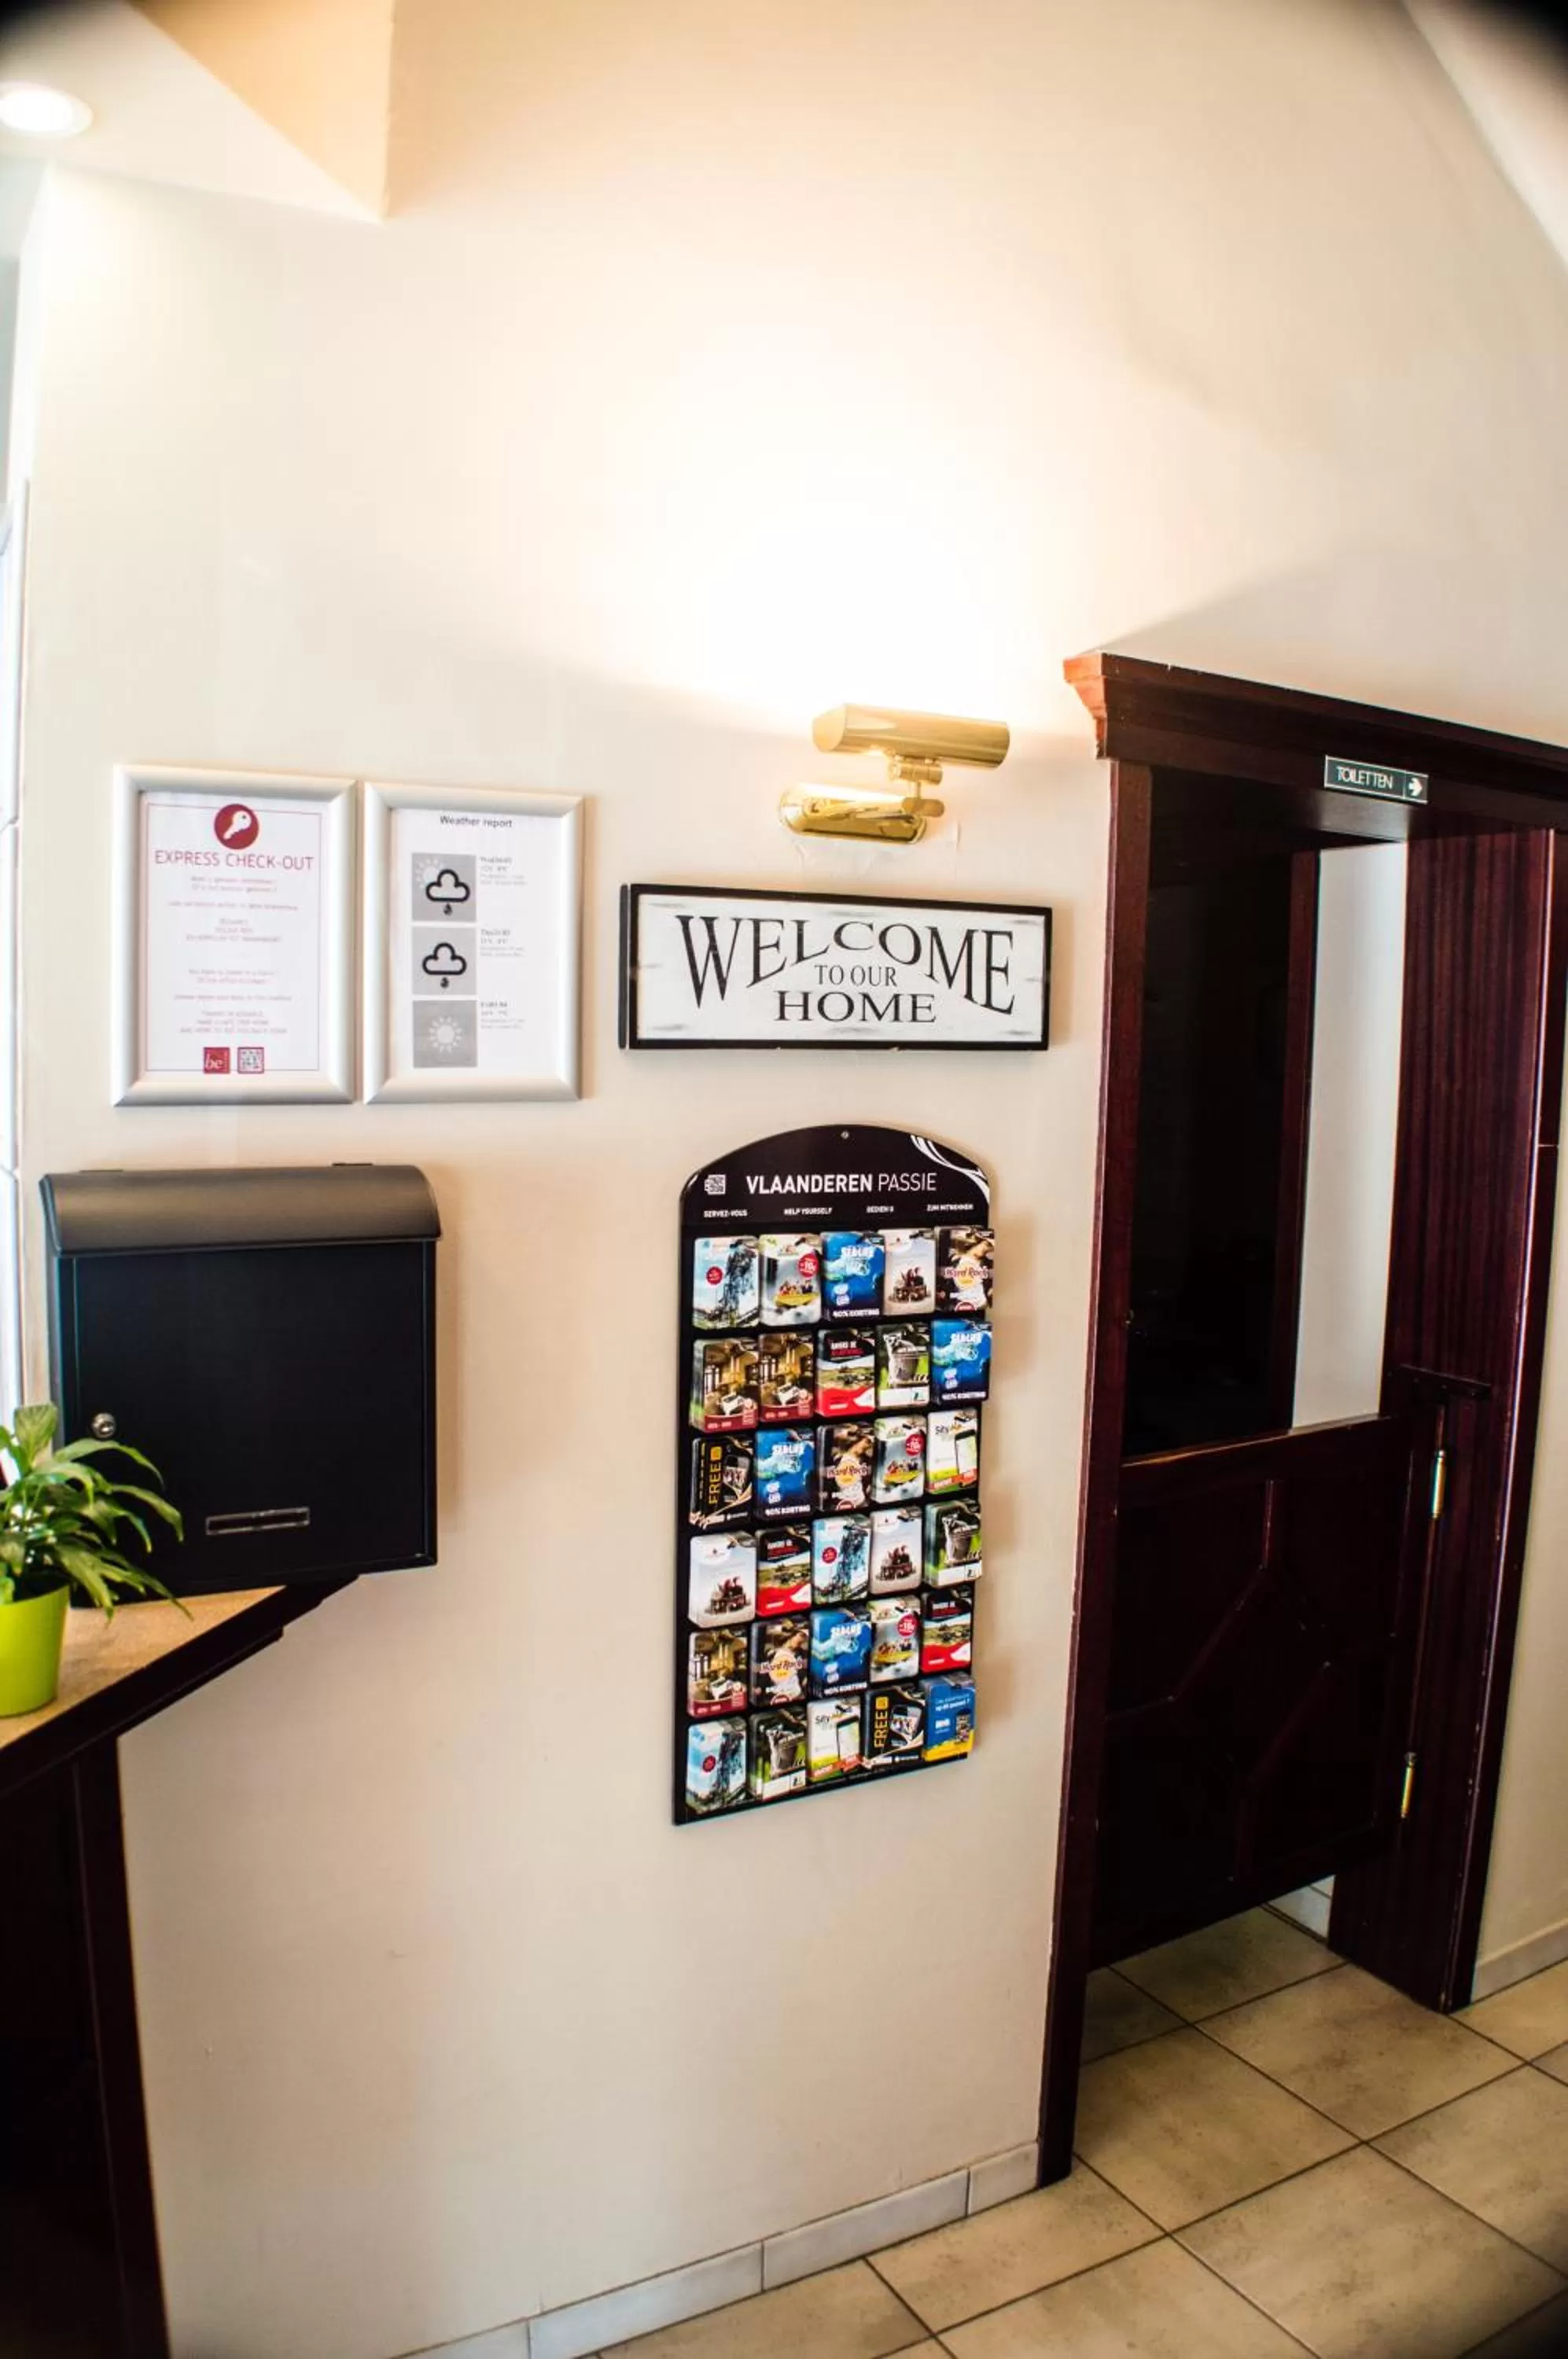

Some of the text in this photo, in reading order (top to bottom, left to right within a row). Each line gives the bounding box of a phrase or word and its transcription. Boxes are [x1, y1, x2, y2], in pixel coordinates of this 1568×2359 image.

[1336, 765, 1393, 789] TOILETTEN
[440, 815, 513, 829] Weather report
[154, 850, 315, 870] EXPRESS CHECK-OUT
[675, 915, 1015, 1015] WELCOME
[814, 964, 897, 987] TO OUR
[774, 990, 937, 1023] HOME
[746, 1172, 937, 1194] VLAANDEREN PASSIE
[709, 1462, 721, 1505] FREE
[874, 1710, 889, 1748] FREE
